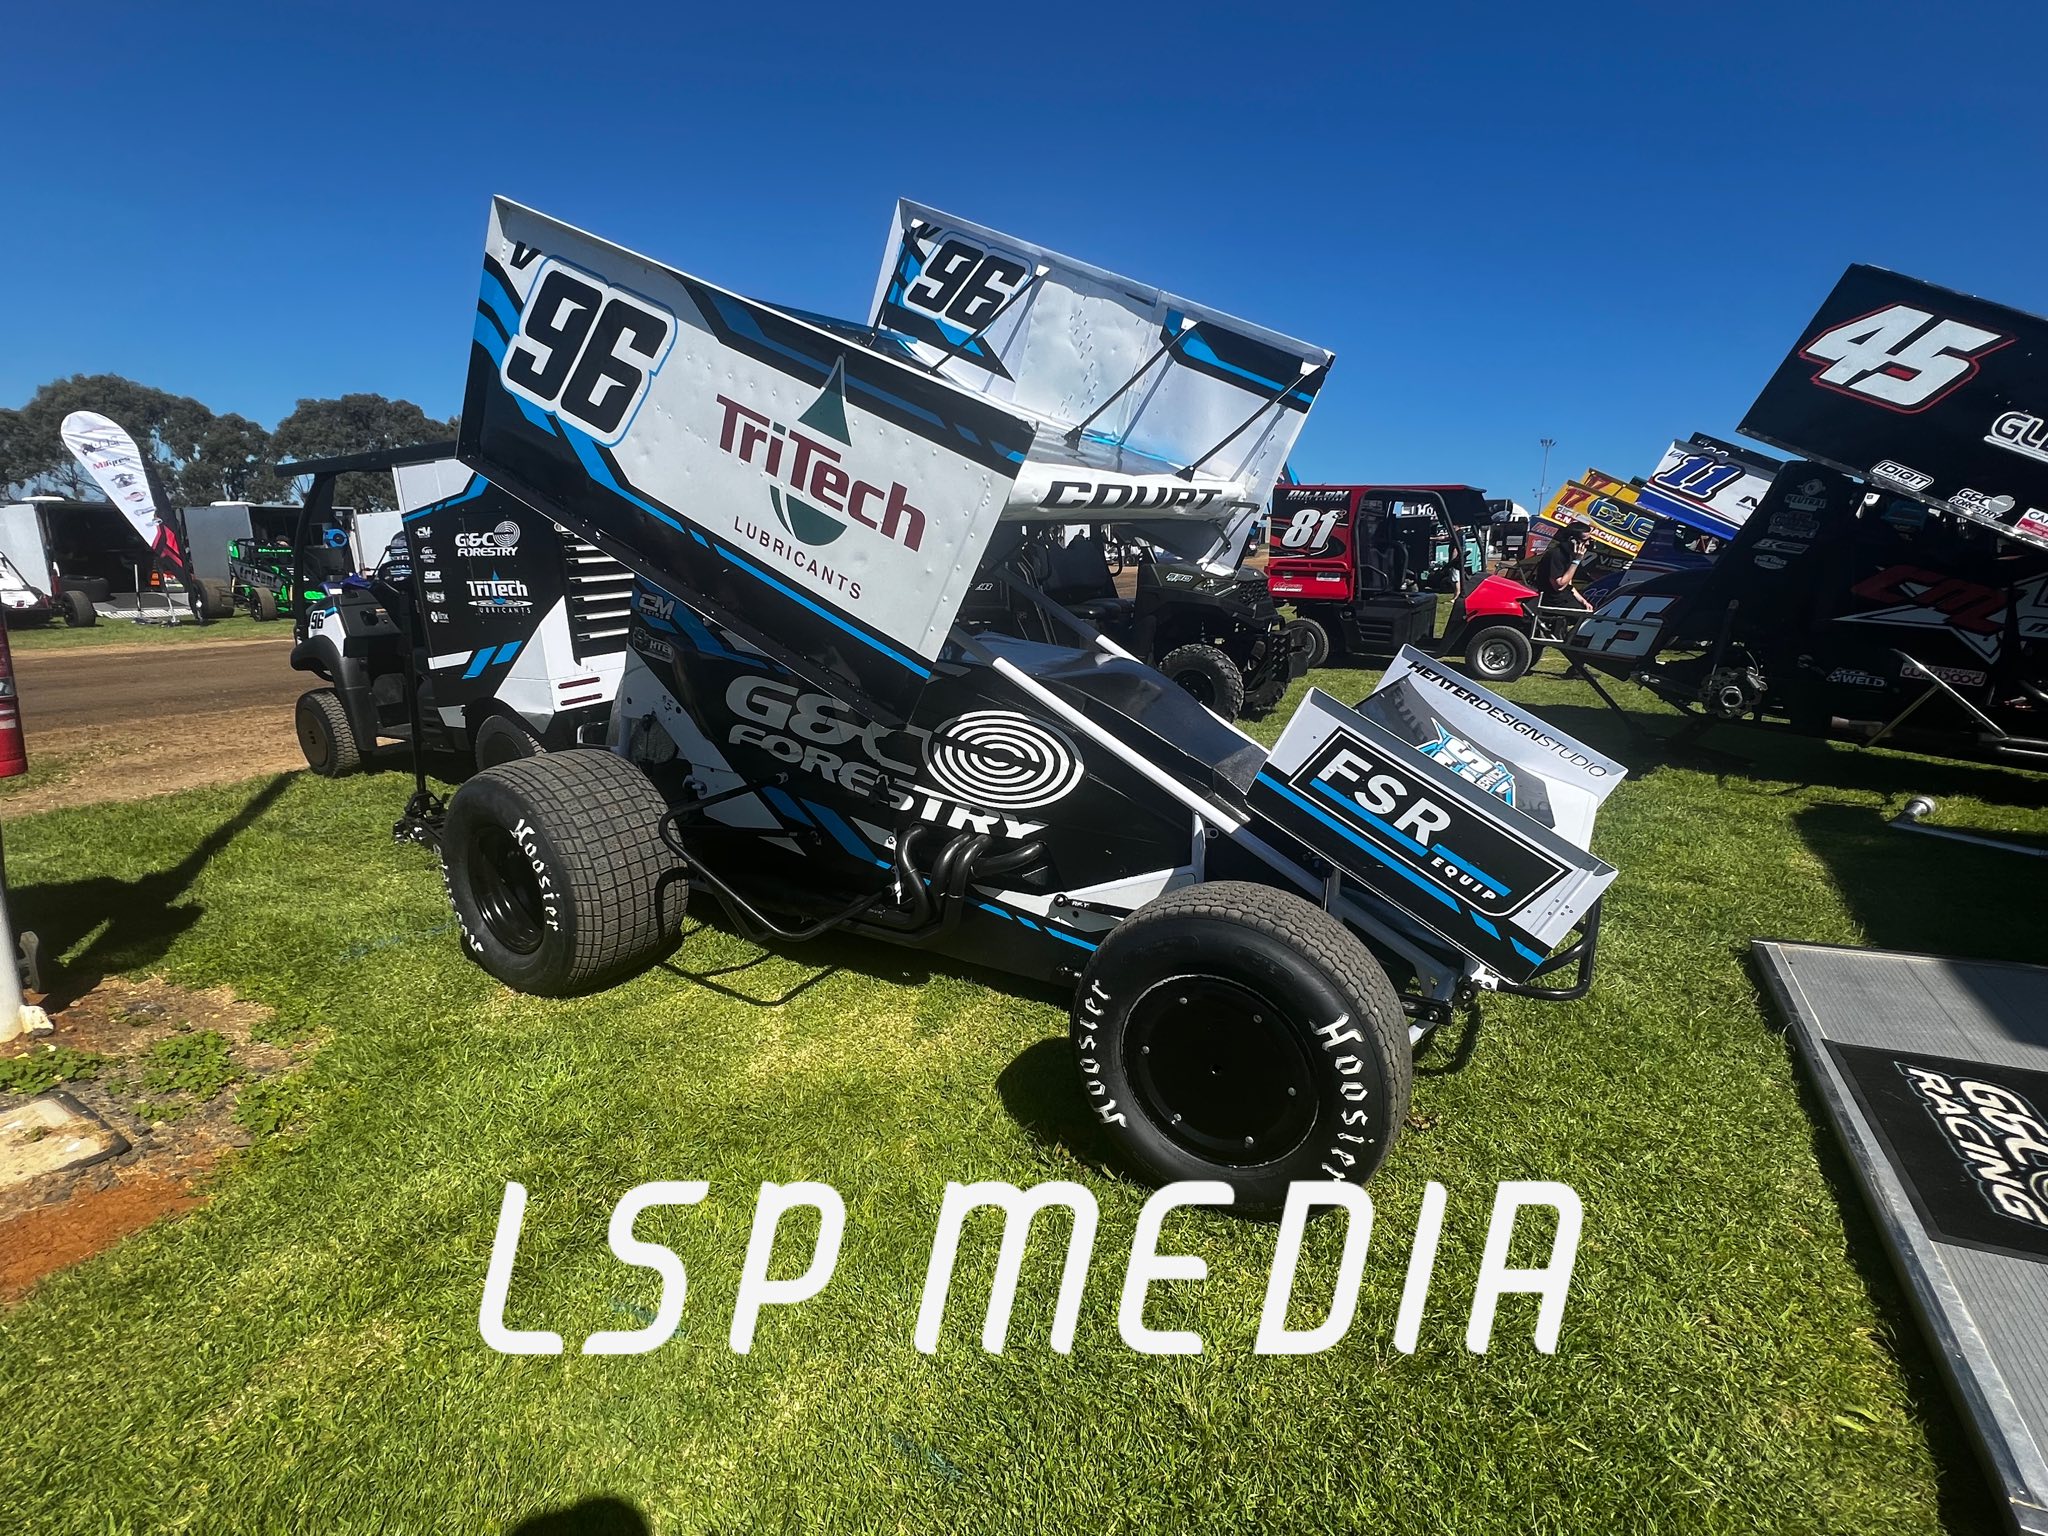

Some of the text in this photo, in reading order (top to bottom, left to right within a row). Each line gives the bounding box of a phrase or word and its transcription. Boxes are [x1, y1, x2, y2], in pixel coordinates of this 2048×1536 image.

[510, 240, 541, 270] V
[907, 239, 1026, 332] 96
[506, 269, 668, 433] 96
[1806, 305, 2002, 405] 45
[716, 393, 926, 552] TriTech
[1557, 486, 1591, 508] 17
[1653, 455, 1744, 500] 11
[1957, 488, 1994, 506] G&C
[455, 532, 495, 546] G&C
[458, 547, 518, 557] FORESTRY
[734, 516, 862, 600] LUBRICANTS
[1282, 509, 1340, 548] 81
[466, 580, 529, 597] TriTech
[310, 612, 326, 630] 96
[1577, 595, 1676, 656] 45
[726, 676, 933, 776] G&C
[728, 724, 1049, 839] FORESTRY
[1317, 748, 1451, 847] FSR
[1430, 856, 1497, 900] EQUIP
[1077, 979, 1128, 1128] Hoosier
[1907, 1067, 2048, 1226] RACING
